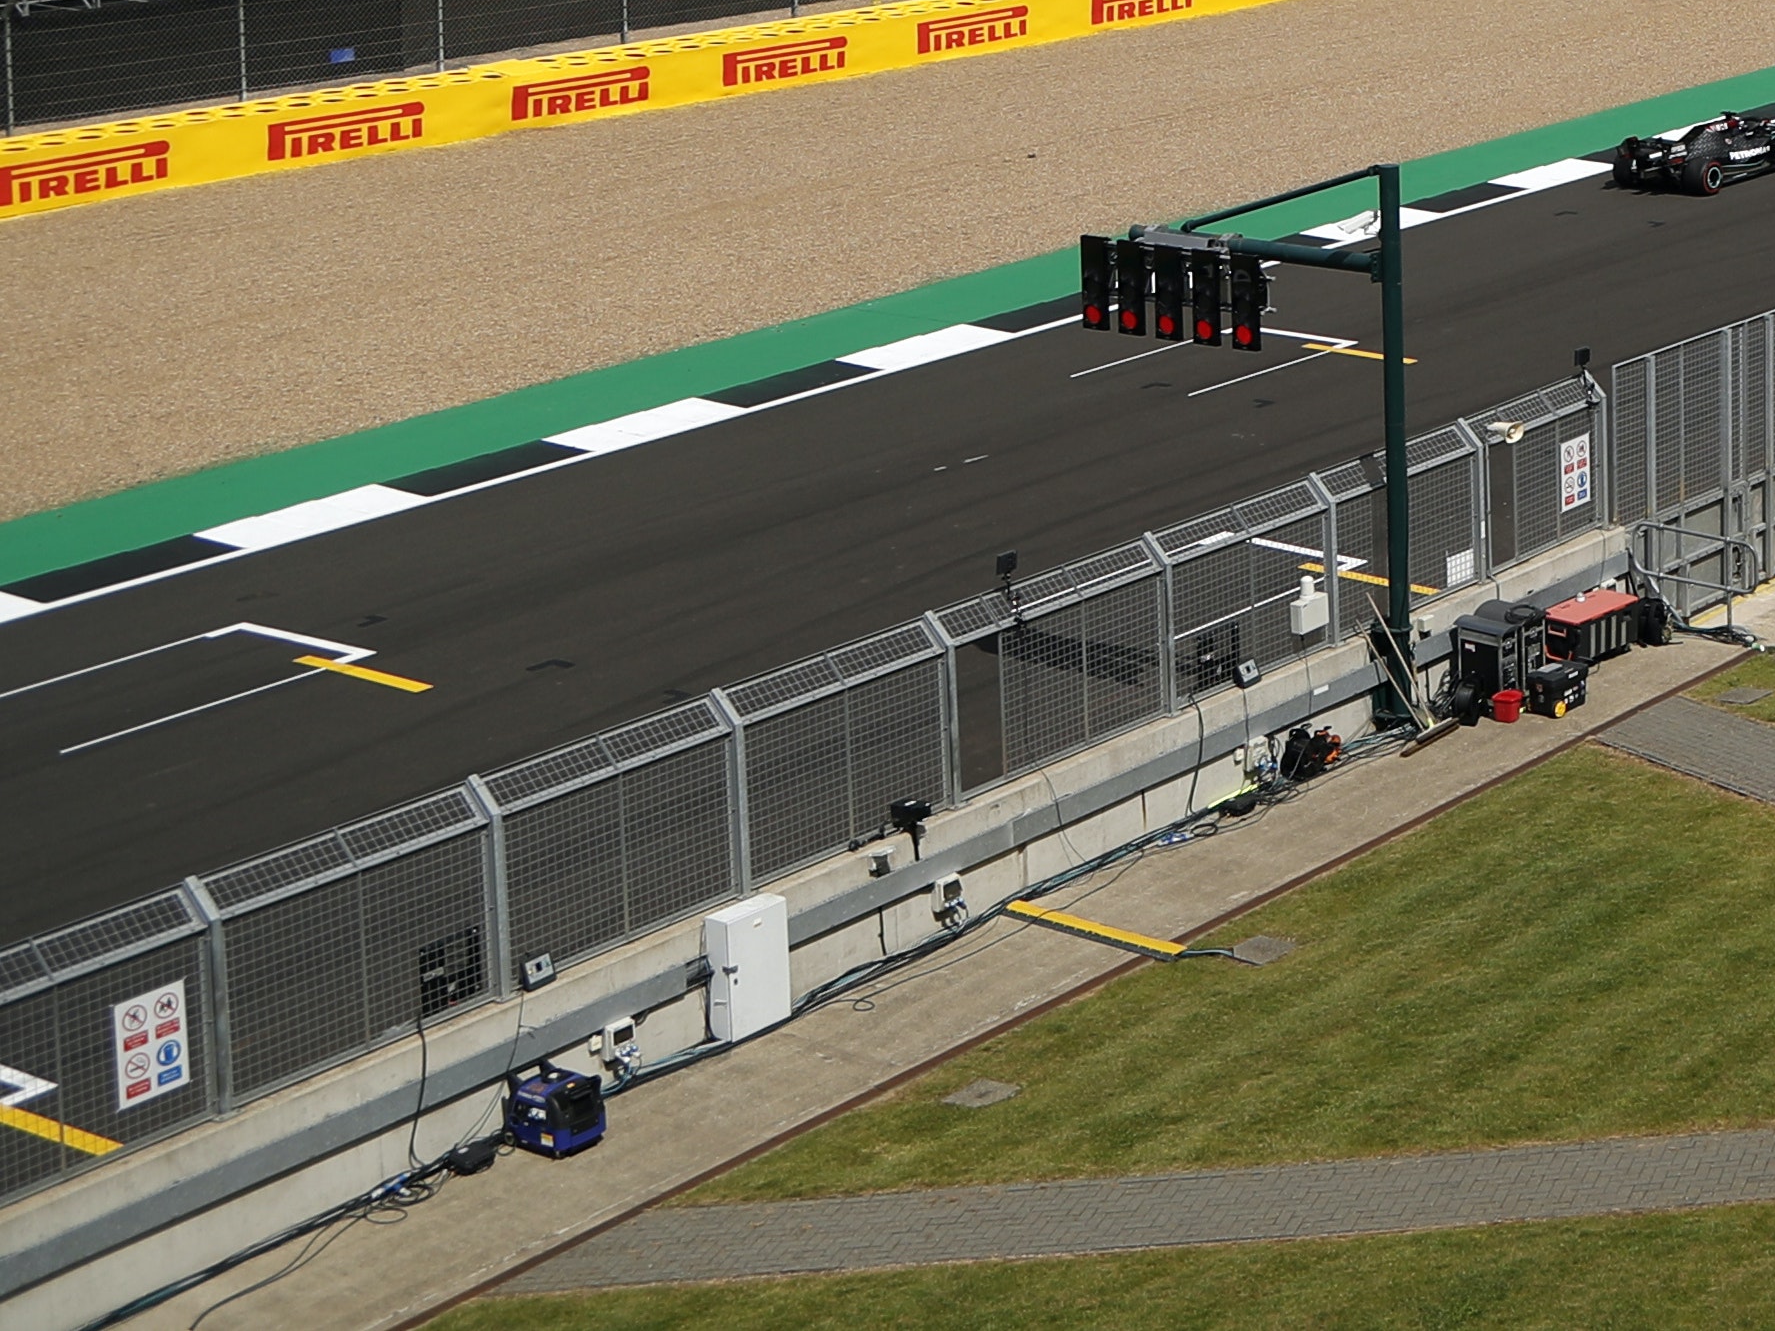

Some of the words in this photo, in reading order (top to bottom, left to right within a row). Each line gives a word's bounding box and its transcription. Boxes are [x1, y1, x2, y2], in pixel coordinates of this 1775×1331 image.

[917, 5, 1029, 54] PIRELLI
[723, 36, 848, 87] PIRELLI
[511, 66, 651, 121] PIRELLI
[267, 101, 425, 161] PIRELLI
[0, 140, 170, 207] PIRELLI
